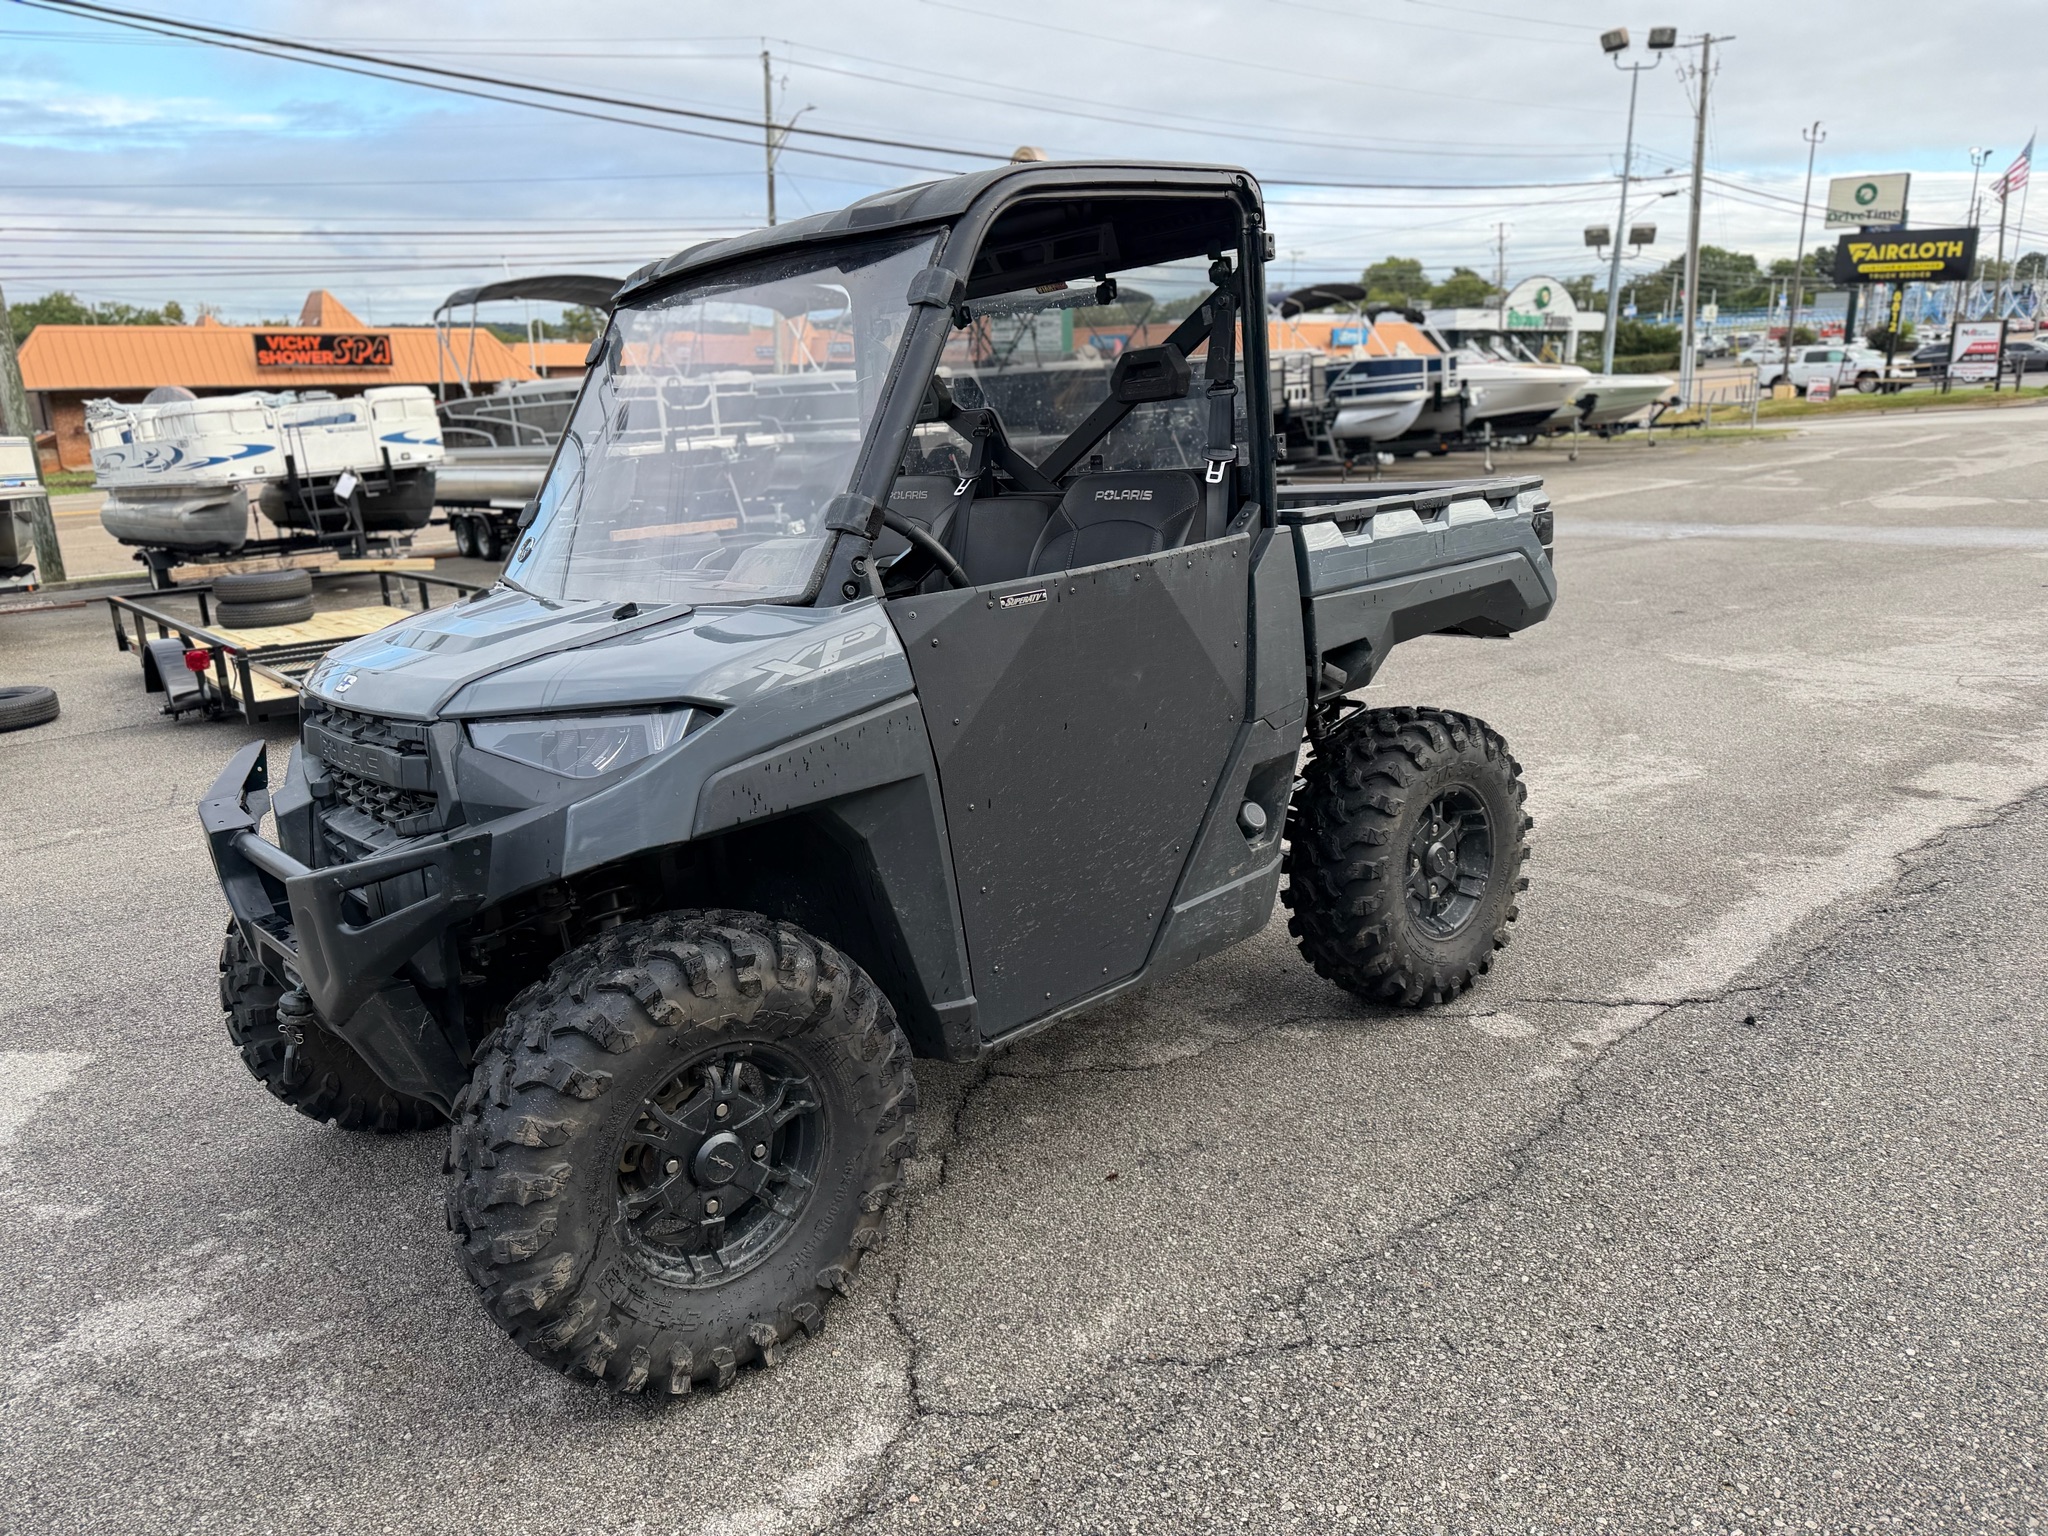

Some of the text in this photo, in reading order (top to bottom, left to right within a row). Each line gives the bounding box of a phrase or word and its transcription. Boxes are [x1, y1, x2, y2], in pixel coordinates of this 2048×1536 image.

[1827, 209, 1900, 222] DriveTime
[1848, 241, 1964, 263] FAIRCLOTH
[265, 335, 321, 350] VICHY
[333, 336, 391, 364] SPA
[257, 350, 334, 365] SHOWER
[1095, 489, 1154, 501] POLARIS
[752, 622, 888, 692] XP
